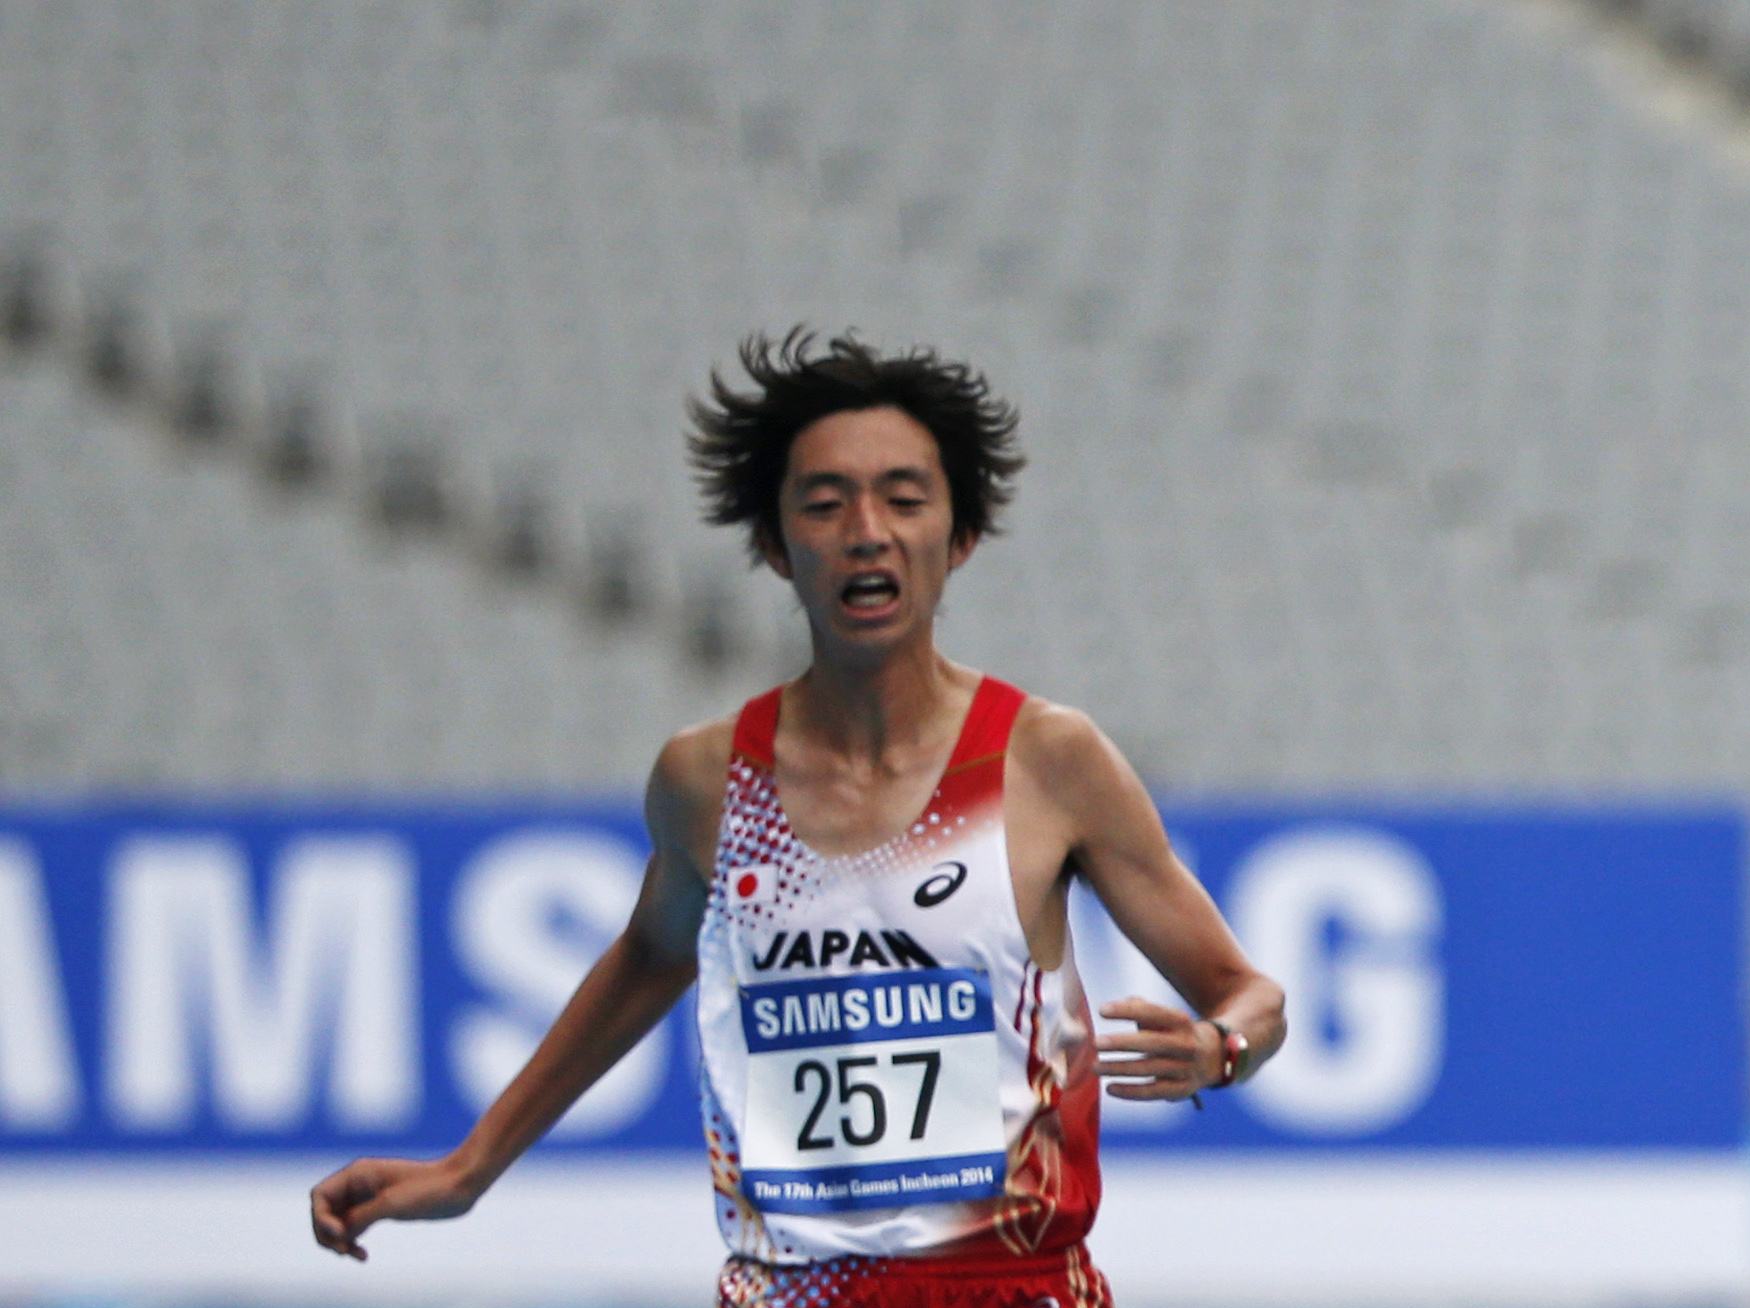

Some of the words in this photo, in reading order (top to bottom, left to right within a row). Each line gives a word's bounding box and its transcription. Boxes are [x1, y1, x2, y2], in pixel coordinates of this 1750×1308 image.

[753, 929, 941, 972] JAPAN
[753, 980, 977, 1040] SAMSUNG
[794, 1050, 941, 1151] 257
[754, 1181, 781, 1198] The
[783, 1183, 813, 1199] 17th
[850, 1179, 899, 1195] Games
[901, 1171, 958, 1191] Incheon
[960, 1166, 993, 1186] 2014
